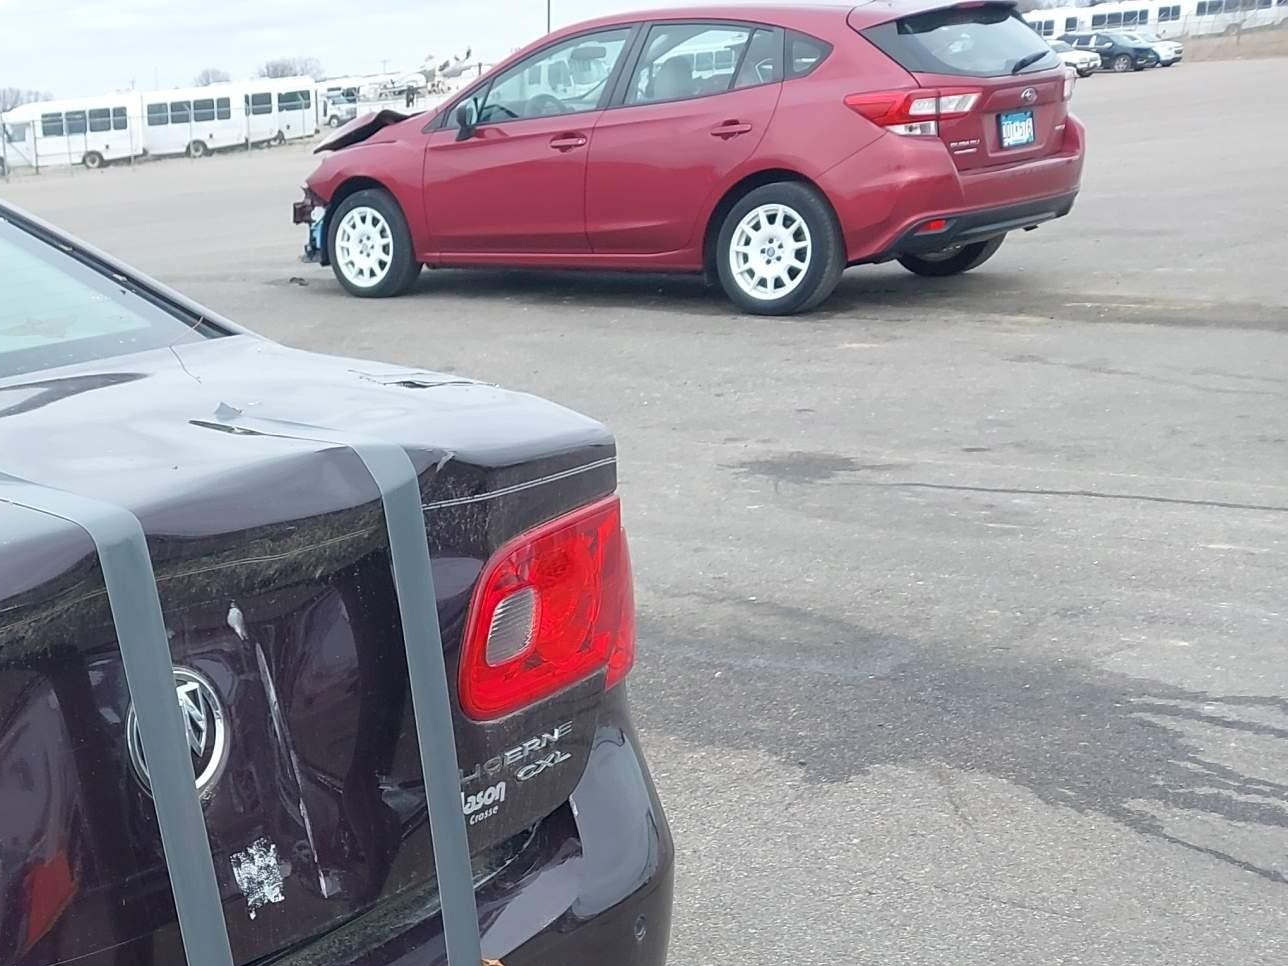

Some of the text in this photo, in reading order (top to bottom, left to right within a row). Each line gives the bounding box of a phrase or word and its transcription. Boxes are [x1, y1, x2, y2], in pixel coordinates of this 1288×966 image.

[458, 719, 575, 782] UCERNE
[514, 750, 573, 781] CXL
[469, 804, 500, 826] Crosse
